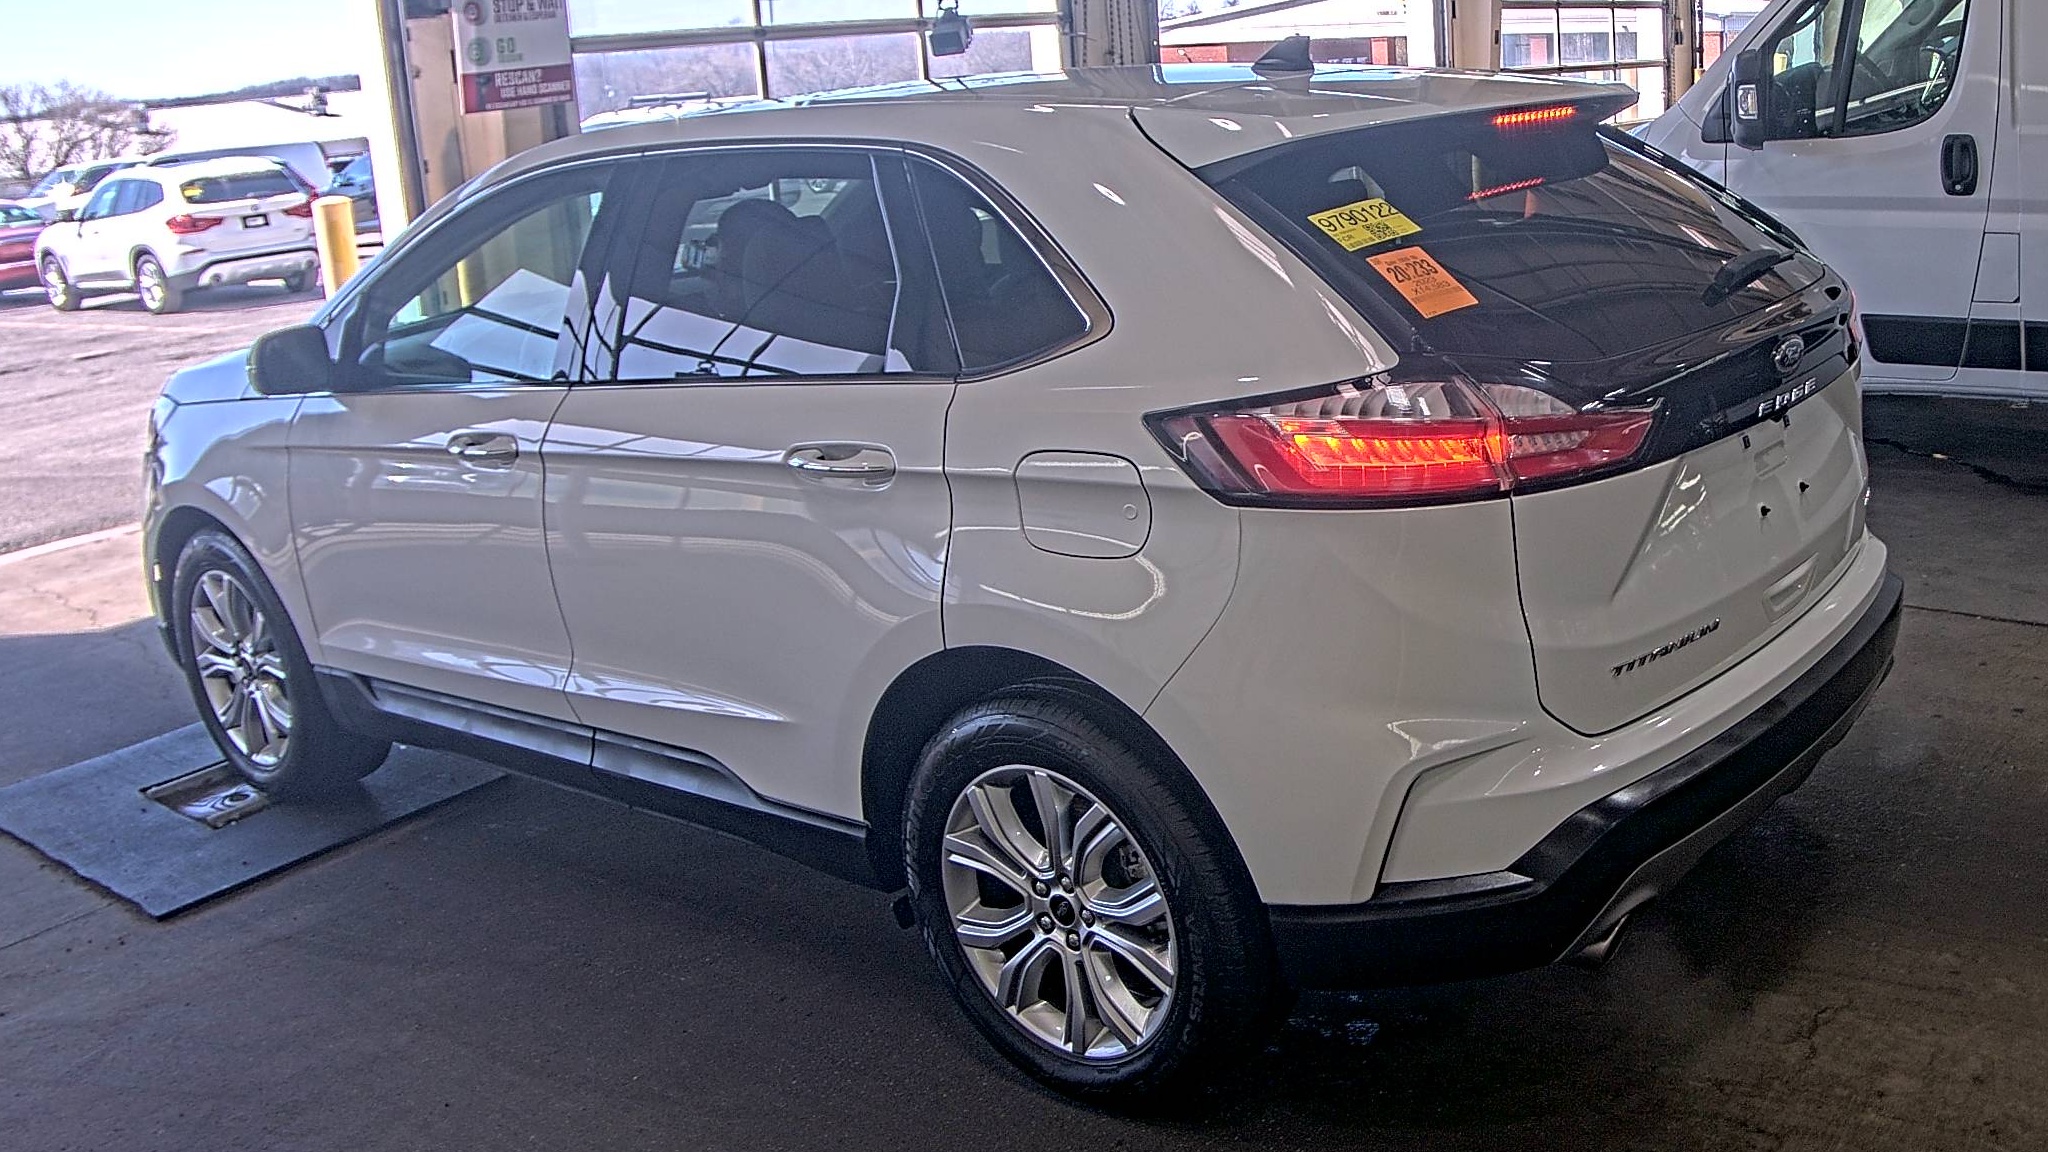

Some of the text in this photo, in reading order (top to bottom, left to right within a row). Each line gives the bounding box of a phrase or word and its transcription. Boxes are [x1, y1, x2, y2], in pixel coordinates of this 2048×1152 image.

[493, 0, 523, 13] STOP
[497, 37, 515, 53] GO
[495, 68, 542, 88] RESCAN?
[1317, 202, 1400, 233] 9790122
[1758, 377, 1817, 418] EDGE
[1611, 617, 1721, 678] TITANIUM
